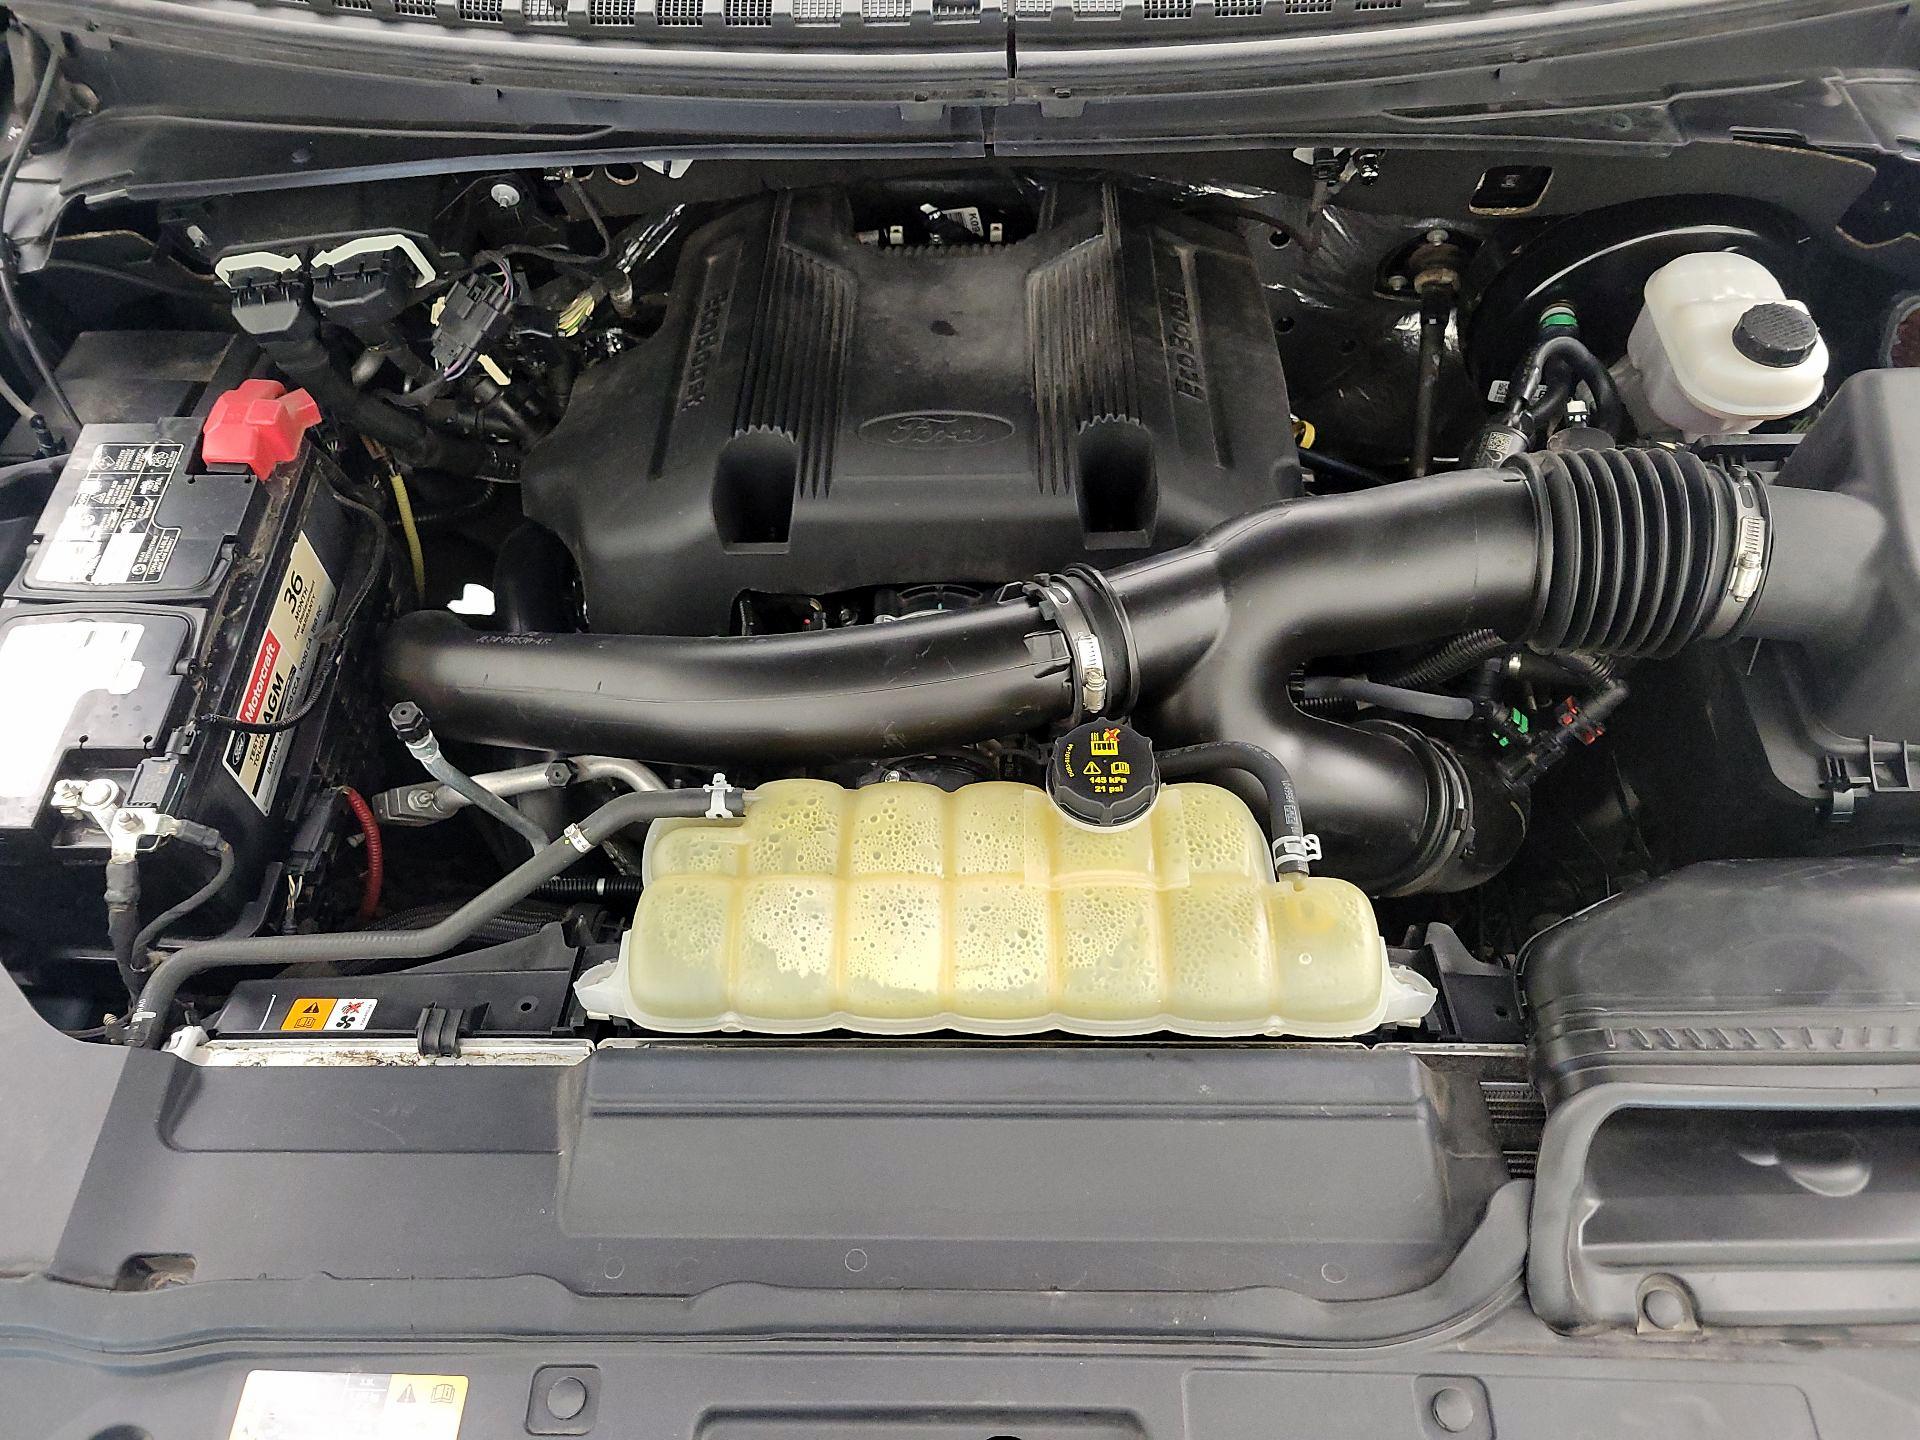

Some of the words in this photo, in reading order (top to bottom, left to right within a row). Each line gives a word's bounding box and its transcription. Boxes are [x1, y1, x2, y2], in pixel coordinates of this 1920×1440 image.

[283, 570, 304, 614] 36
[294, 586, 308, 621] MONTH
[244, 642, 275, 722] Motorcraft
[262, 671, 284, 723] AGM
[1089, 776, 1107, 784] 145
[1108, 776, 1128, 784] kPa
[1094, 785, 1107, 793] 21
[1108, 785, 1124, 794] psi
